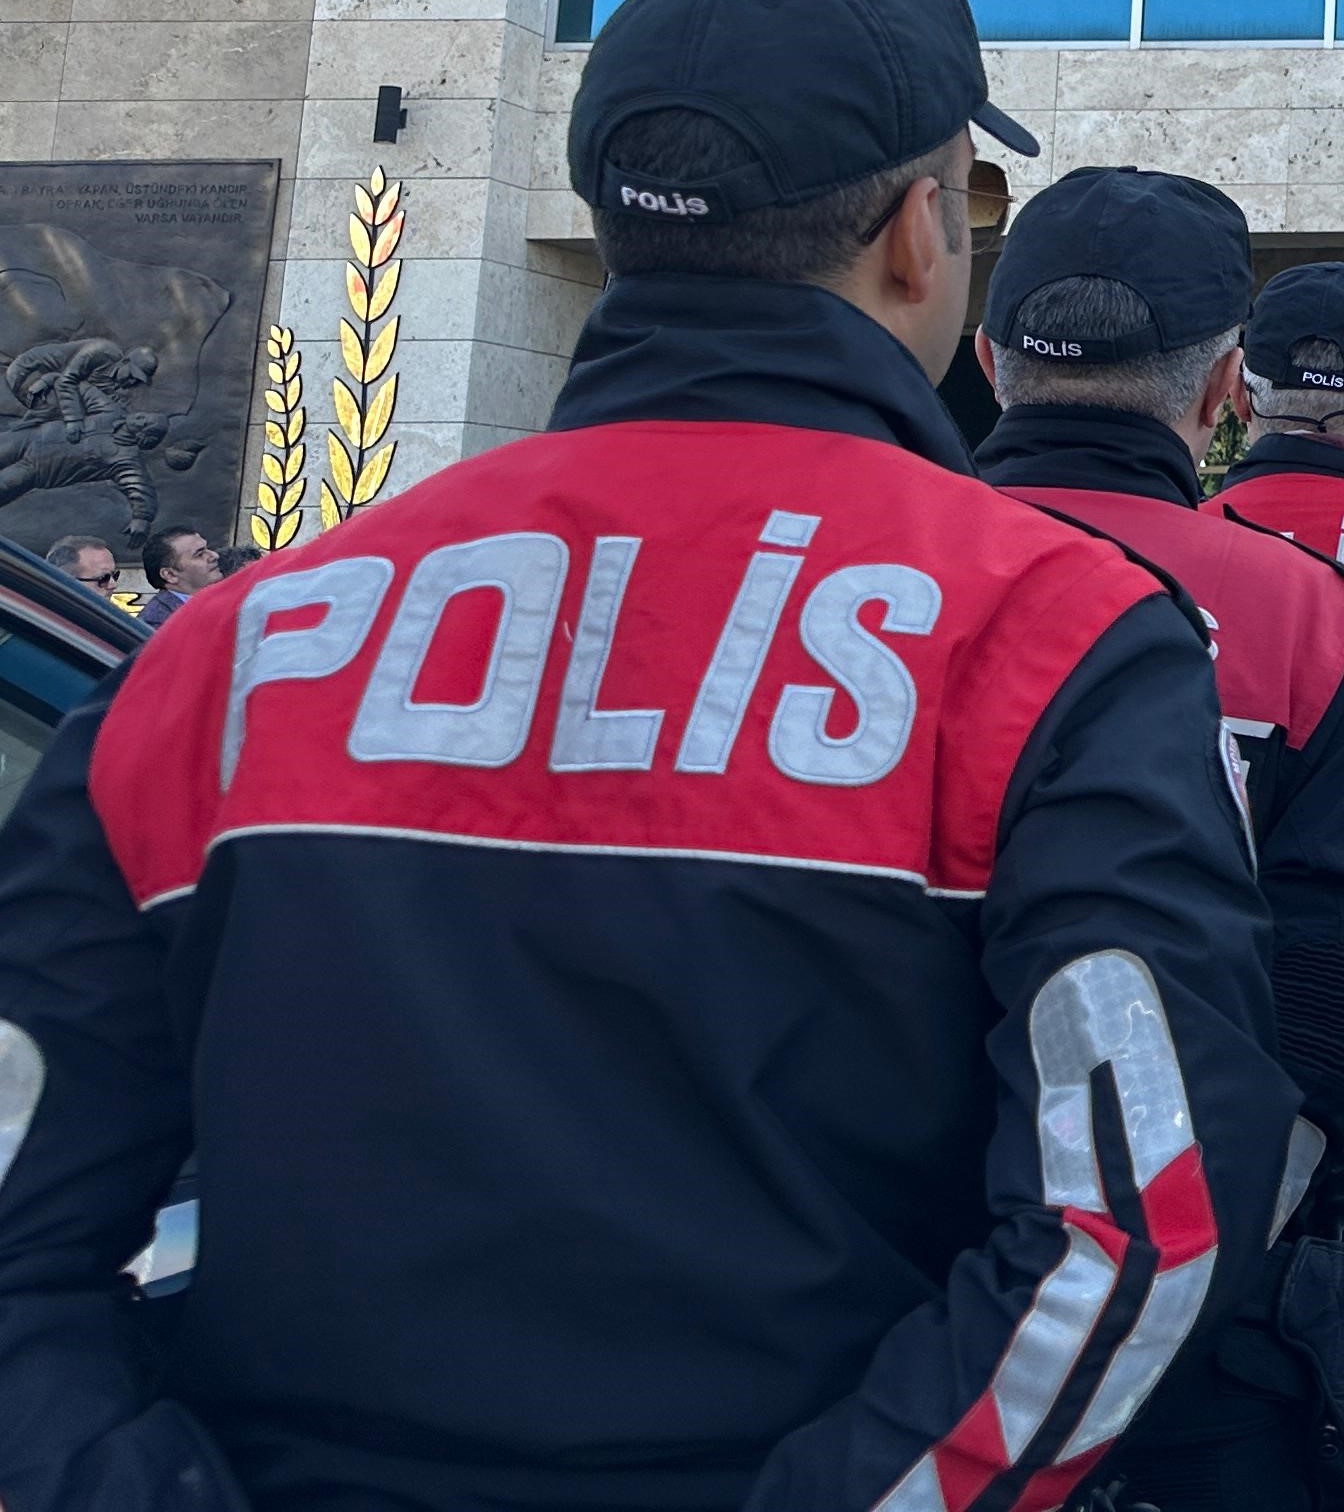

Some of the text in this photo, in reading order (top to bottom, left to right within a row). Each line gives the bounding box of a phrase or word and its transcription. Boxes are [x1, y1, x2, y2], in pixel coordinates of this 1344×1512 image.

[620, 183, 711, 218] POLİS
[1021, 333, 1083, 358] POLİS
[1301, 369, 1344, 389] POLİS
[218, 510, 944, 793] POLİS
